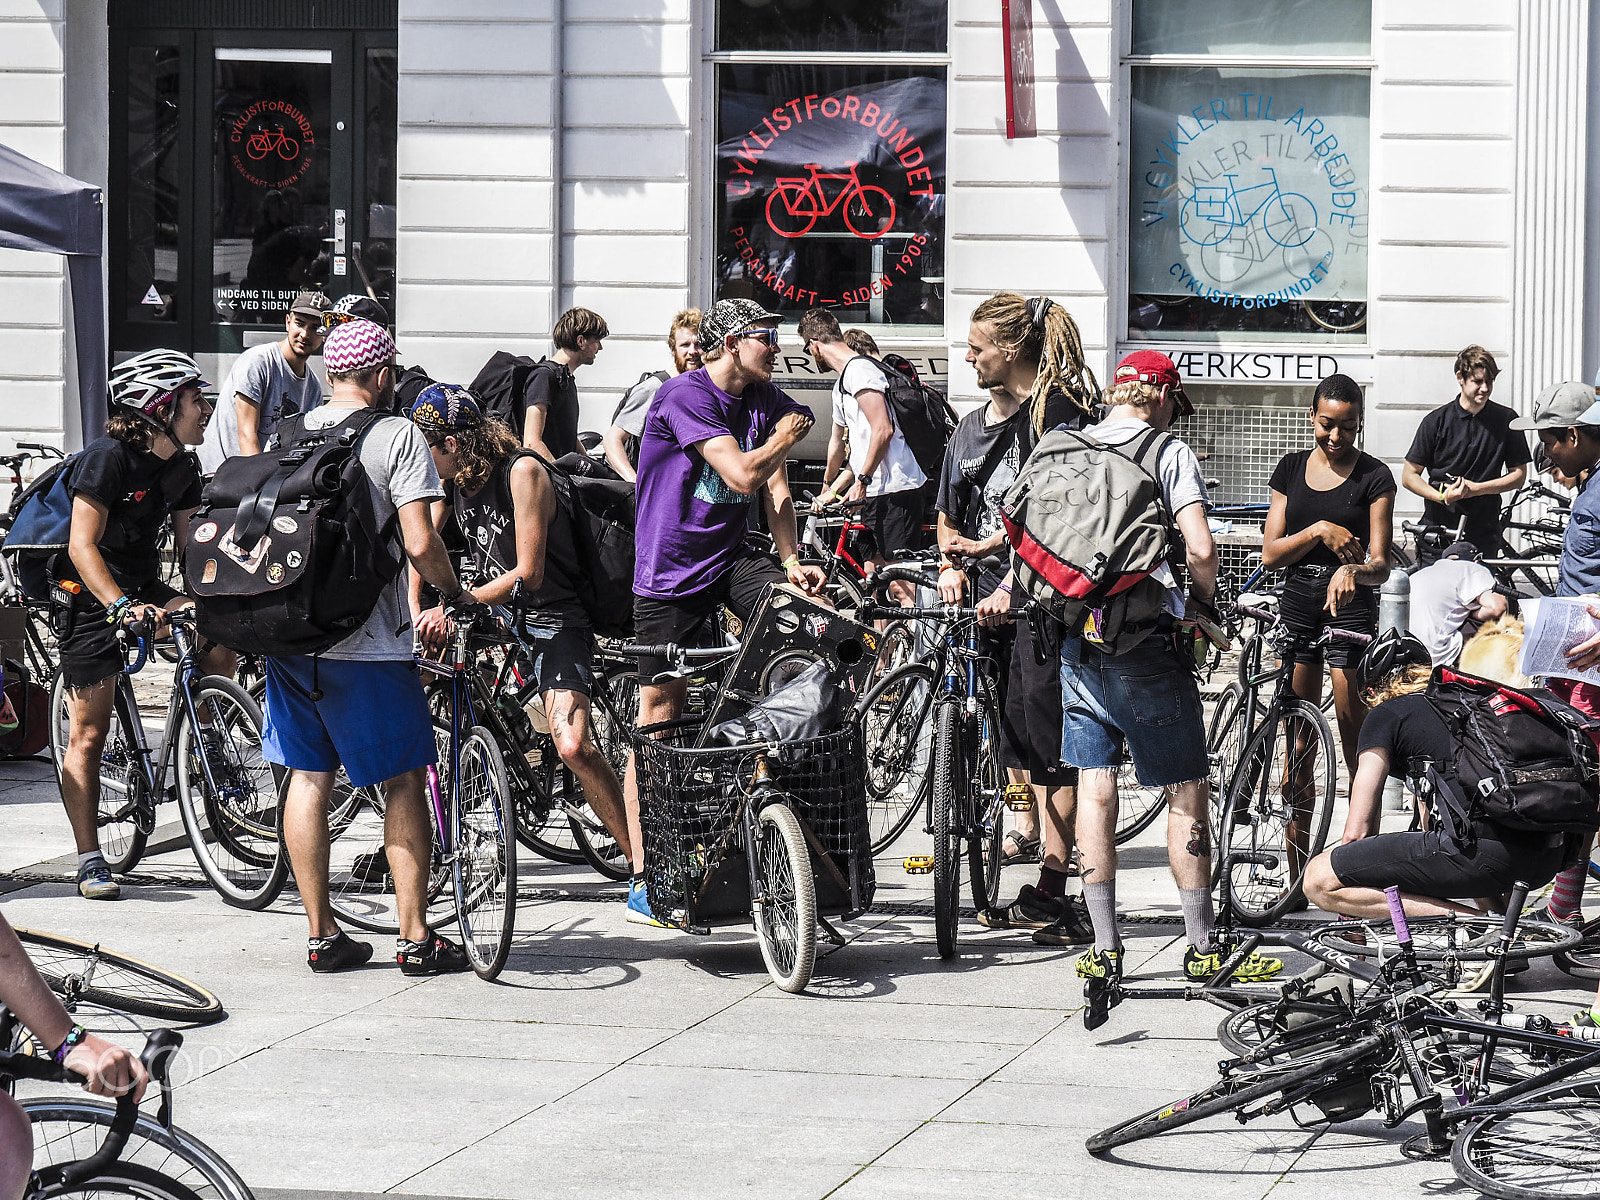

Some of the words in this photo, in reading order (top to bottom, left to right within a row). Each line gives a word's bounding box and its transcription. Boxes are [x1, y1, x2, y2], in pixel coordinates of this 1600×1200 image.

[1238, 93, 1277, 121] TIL
[231, 100, 315, 144] CYKLISTFORBUNDET
[727, 94, 934, 200] CYKLISTFORBUNDET
[1145, 98, 1231, 188] CYKLER
[1284, 108, 1356, 229] ARBEJDE
[1143, 200, 1168, 227] VI
[729, 226, 818, 305] PEDALKRAFT
[842, 273, 893, 306] SIDEN
[895, 233, 927, 275] 1905
[217, 289, 259, 299] INDGANG
[262, 289, 275, 300] TIL
[240, 300, 259, 310] VED
[261, 300, 289, 310] SIDEN
[1038, 487, 1129, 515] SCUM
[459, 507, 476, 528] AST
[482, 504, 511, 528] VAN
